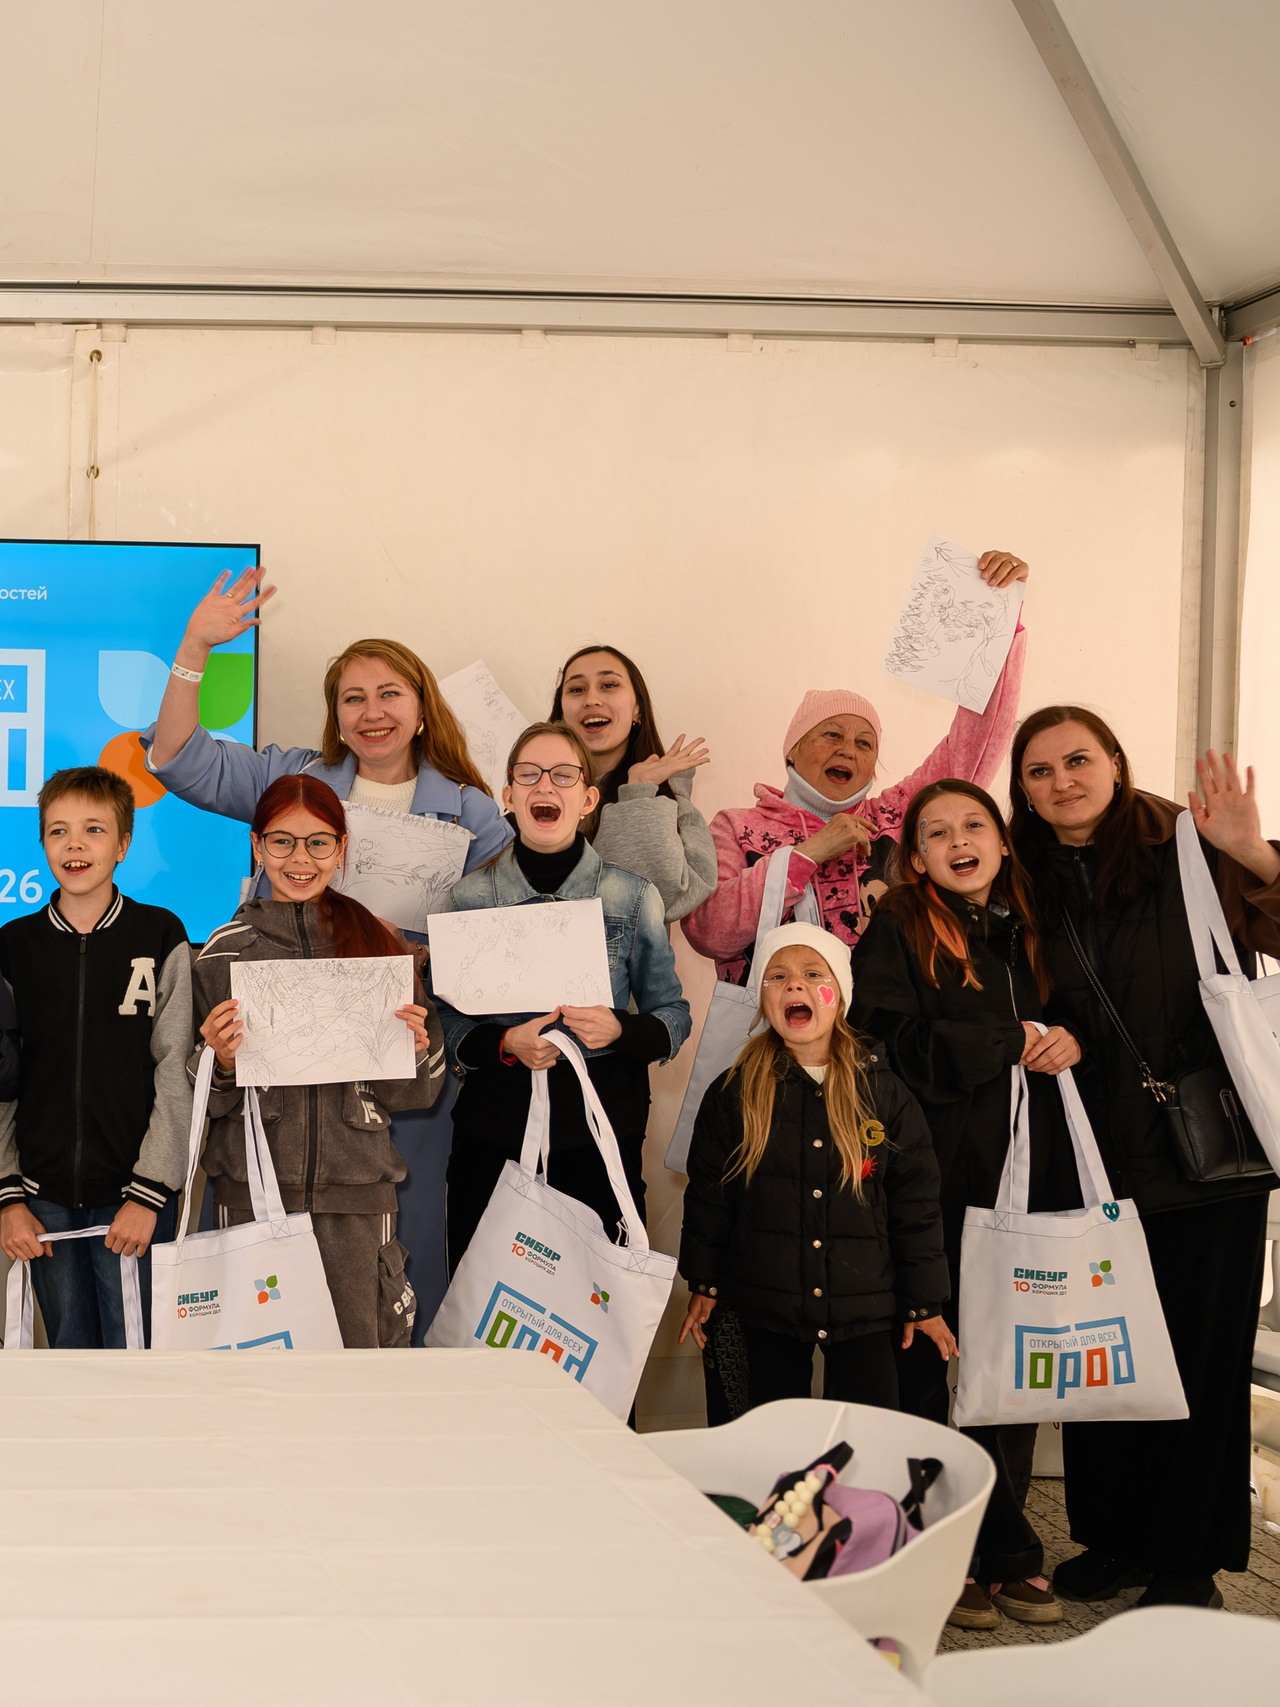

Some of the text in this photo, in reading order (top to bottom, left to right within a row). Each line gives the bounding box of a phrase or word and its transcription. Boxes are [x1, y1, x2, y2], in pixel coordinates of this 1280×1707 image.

[118, 957, 157, 1017] A
[859, 1119, 885, 1147] G
[511, 1243, 556, 1272] 10 ФОРМУЛА
[515, 1231, 561, 1262] СИБУР
[1013, 1267, 1068, 1282] СИБУР
[1013, 1280, 1067, 1292] 10 ФОРМУЛА
[177, 1289, 219, 1306] СИБУР
[176, 1303, 220, 1319] 10 ФОРМУЛА
[501, 1298, 583, 1354] ОТКРЫТЫЙ ДЛЯ ВСЕХ
[1029, 1331, 1118, 1349] ОТКРЫТЫЙ ДЛЯ ВСЕХ
